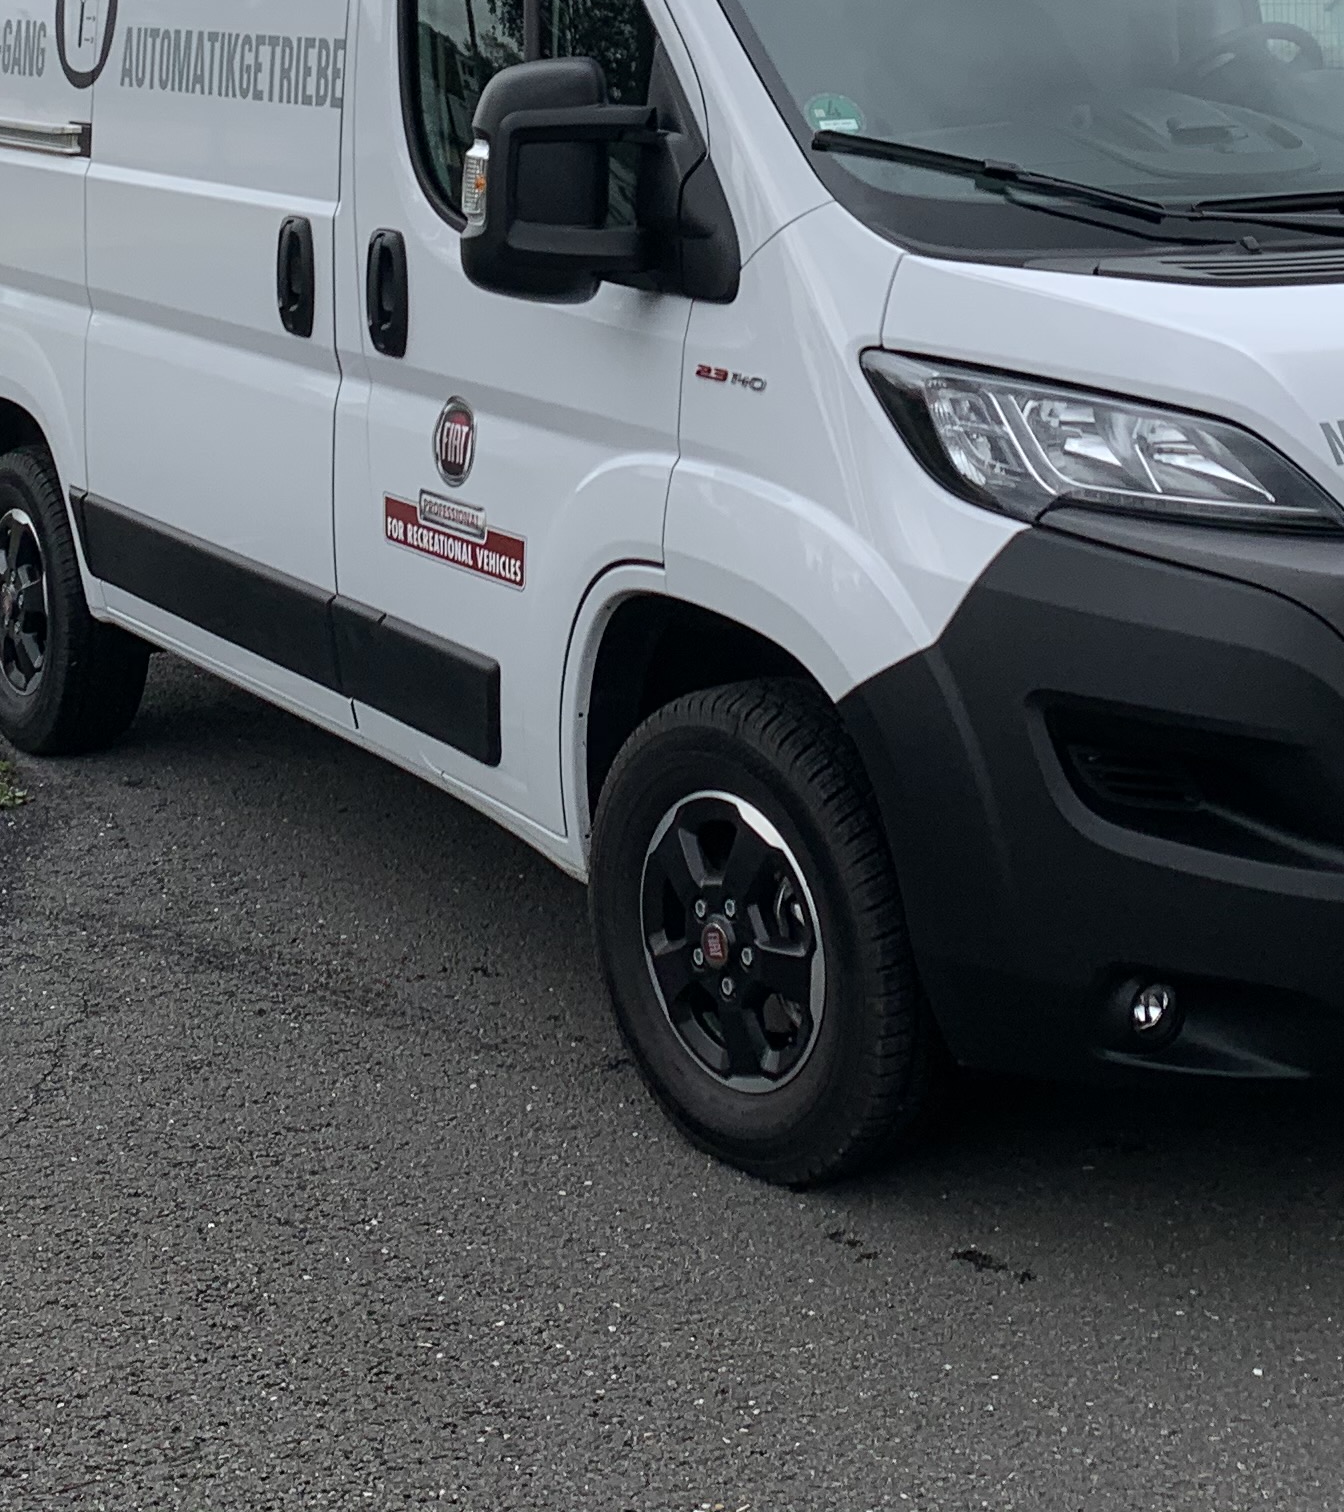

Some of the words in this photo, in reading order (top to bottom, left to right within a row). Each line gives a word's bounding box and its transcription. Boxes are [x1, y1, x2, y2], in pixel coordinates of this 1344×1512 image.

[119, 26, 347, 110] AUTOMATIKGETRIEBE
[442, 420, 470, 466] FIAT
[422, 497, 480, 527] PROFESSIONAL
[387, 516, 405, 541] FOR
[407, 522, 473, 566] RECREATIONAL
[476, 546, 522, 583] VEHICLES
